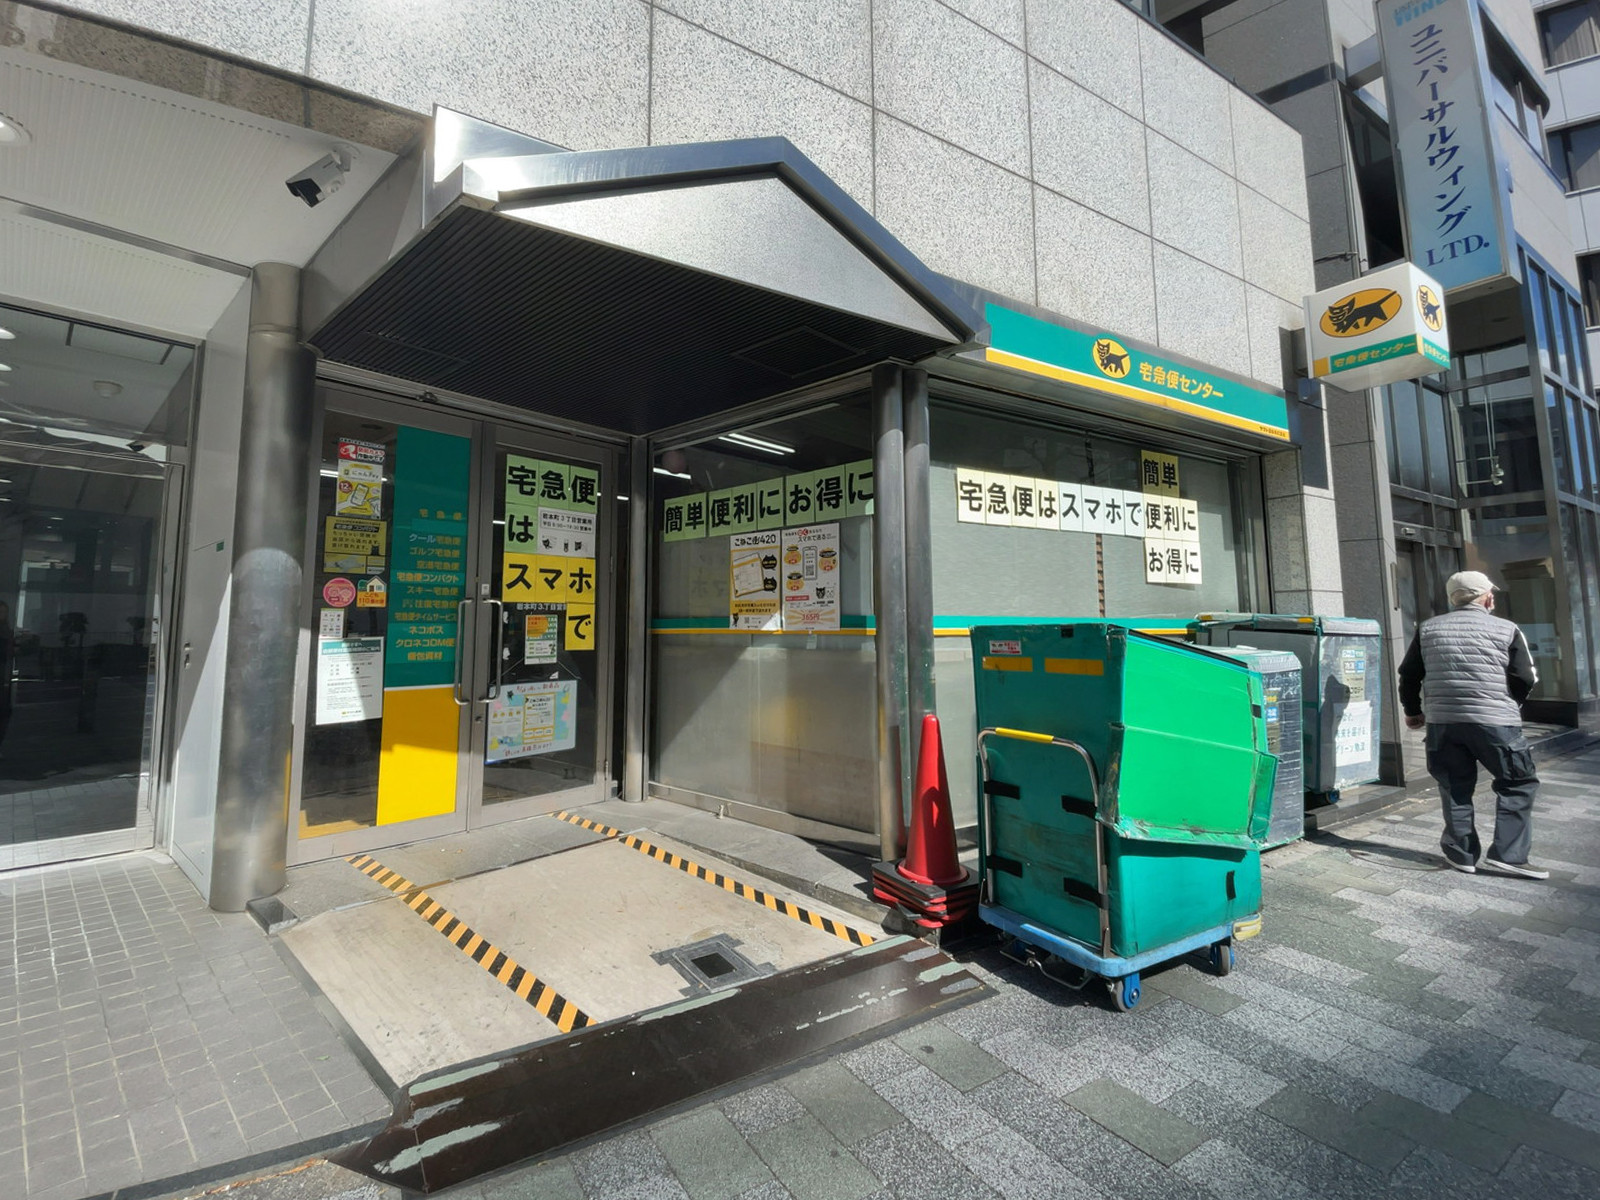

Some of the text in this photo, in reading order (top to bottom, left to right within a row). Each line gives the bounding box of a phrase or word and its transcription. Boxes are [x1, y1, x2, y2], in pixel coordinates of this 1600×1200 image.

[1410, 24, 1472, 238] ユニバーサルウィング
[1426, 234, 1490, 268] LTD.
[1333, 341, 1416, 368] 宅急便センター
[1139, 361, 1224, 399] 宅急便センター
[507, 465, 597, 506] 宅急便
[1143, 459, 1178, 488] 簡単
[665, 472, 874, 534] 簡単便利にお得に
[959, 479, 1197, 532] 宅急便はスマホで便利に
[409, 533, 461, 545] クール宅急便
[508, 514, 534, 543] は
[410, 546, 460, 558] ゴルフ宅急便
[1148, 547, 1200, 576] お得に
[397, 572, 459, 583] 宅急便コンパクト
[407, 585, 459, 596] スキー宅急便
[506, 563, 592, 594] スマホ
[409, 625, 444, 635] ネコポス
[568, 614, 591, 640] で
[396, 638, 455, 648] クロネコDM便
